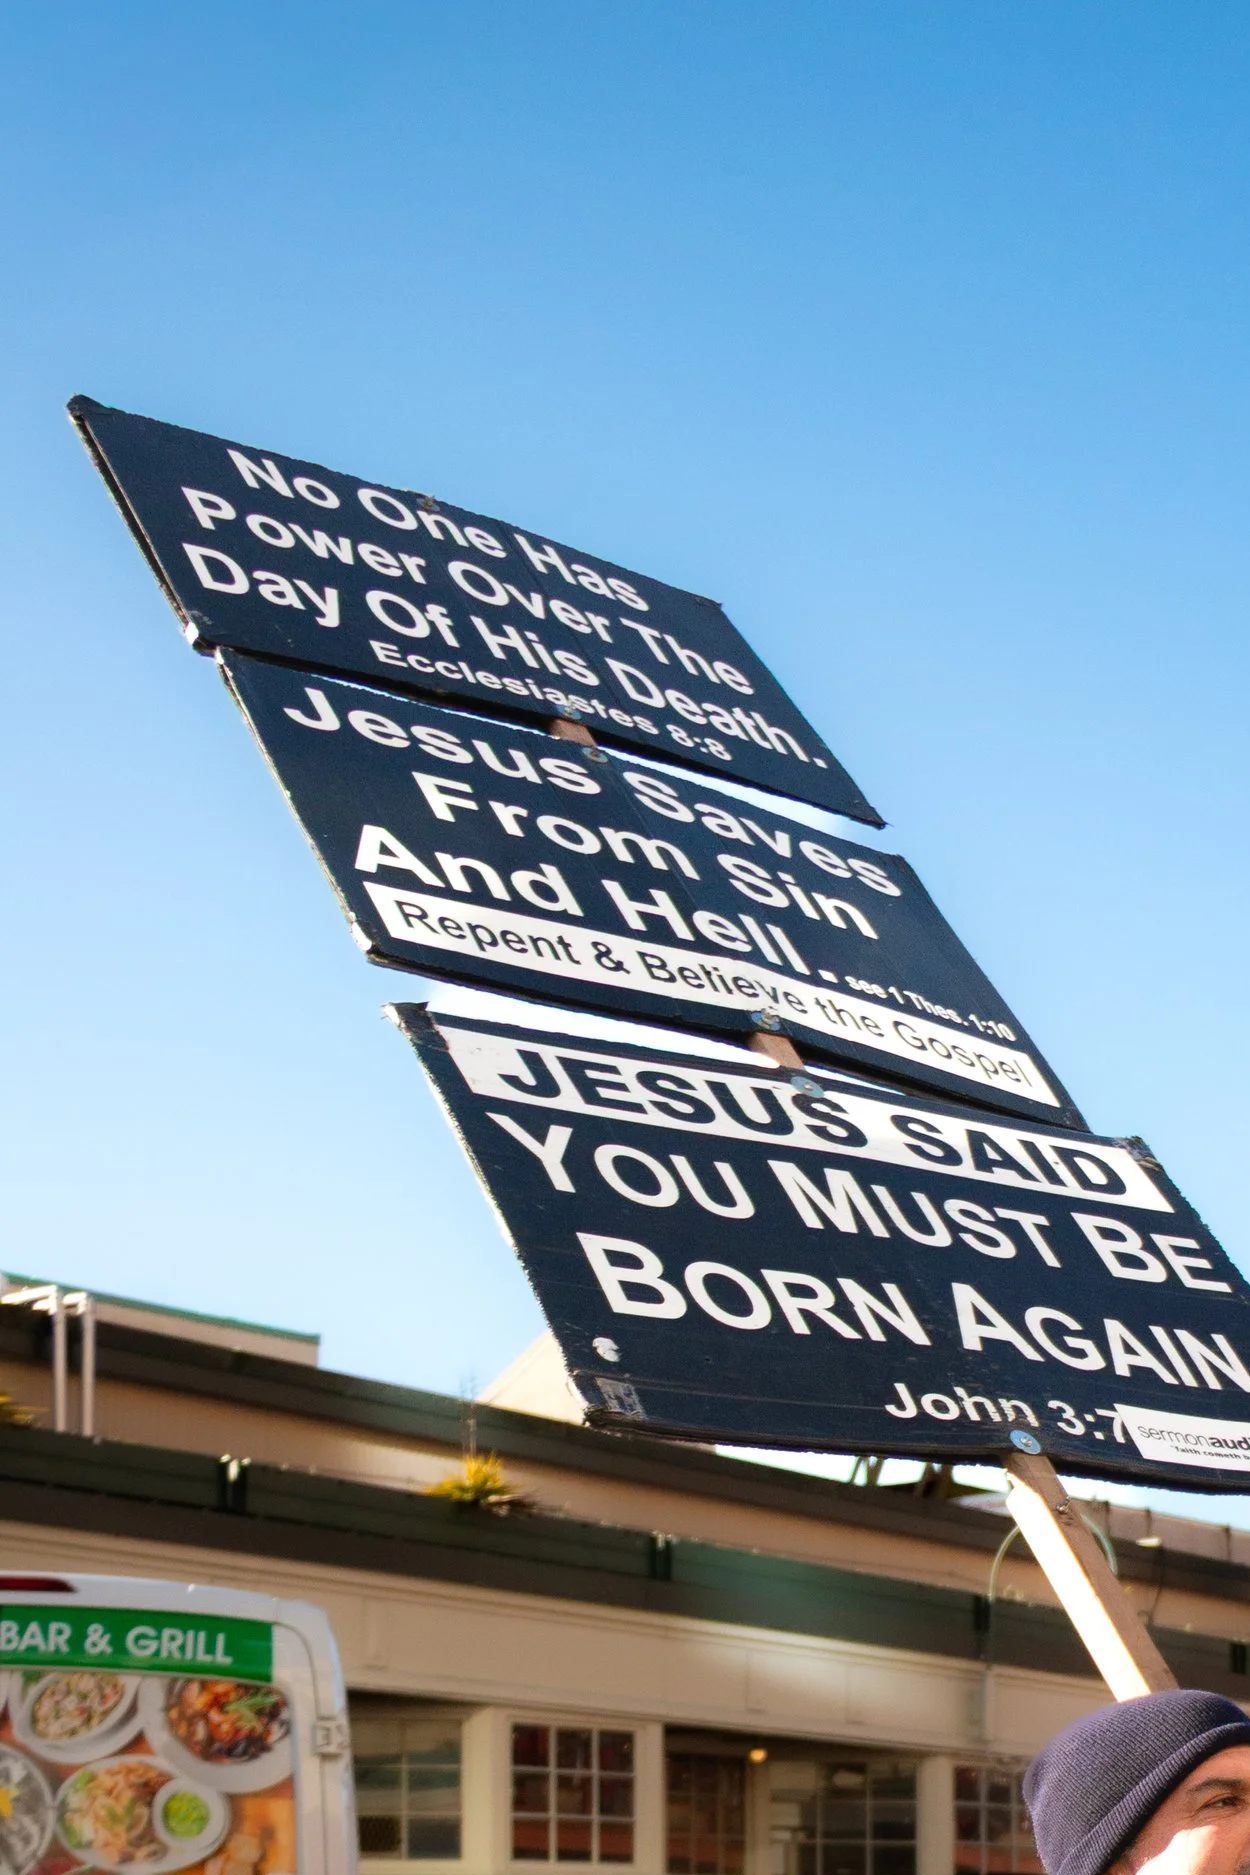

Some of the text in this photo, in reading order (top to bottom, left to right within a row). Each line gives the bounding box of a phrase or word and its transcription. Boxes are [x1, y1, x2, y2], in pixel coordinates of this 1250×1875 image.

[182, 487, 753, 694] Power Over The
[227, 449, 649, 611] No One Has
[183, 543, 827, 768] Day Of His Death.
[370, 640, 731, 760] Ecclesiastes 8:8
[284, 688, 901, 896] Jesus Saves
[412, 772, 878, 939] From Sin
[355, 825, 1016, 1041] And Hell. see 1 Thes. 1:10
[396, 901, 1033, 1087] Repent & Believe the Gospel
[486, 1113, 1229, 1292] YOU MUST BE
[499, 1049, 1126, 1194] JESUS SAID
[576, 1232, 931, 1345] BORN
[885, 1383, 1126, 1443] John 3:7
[0, 1619, 234, 1666] BAR & GRILL
